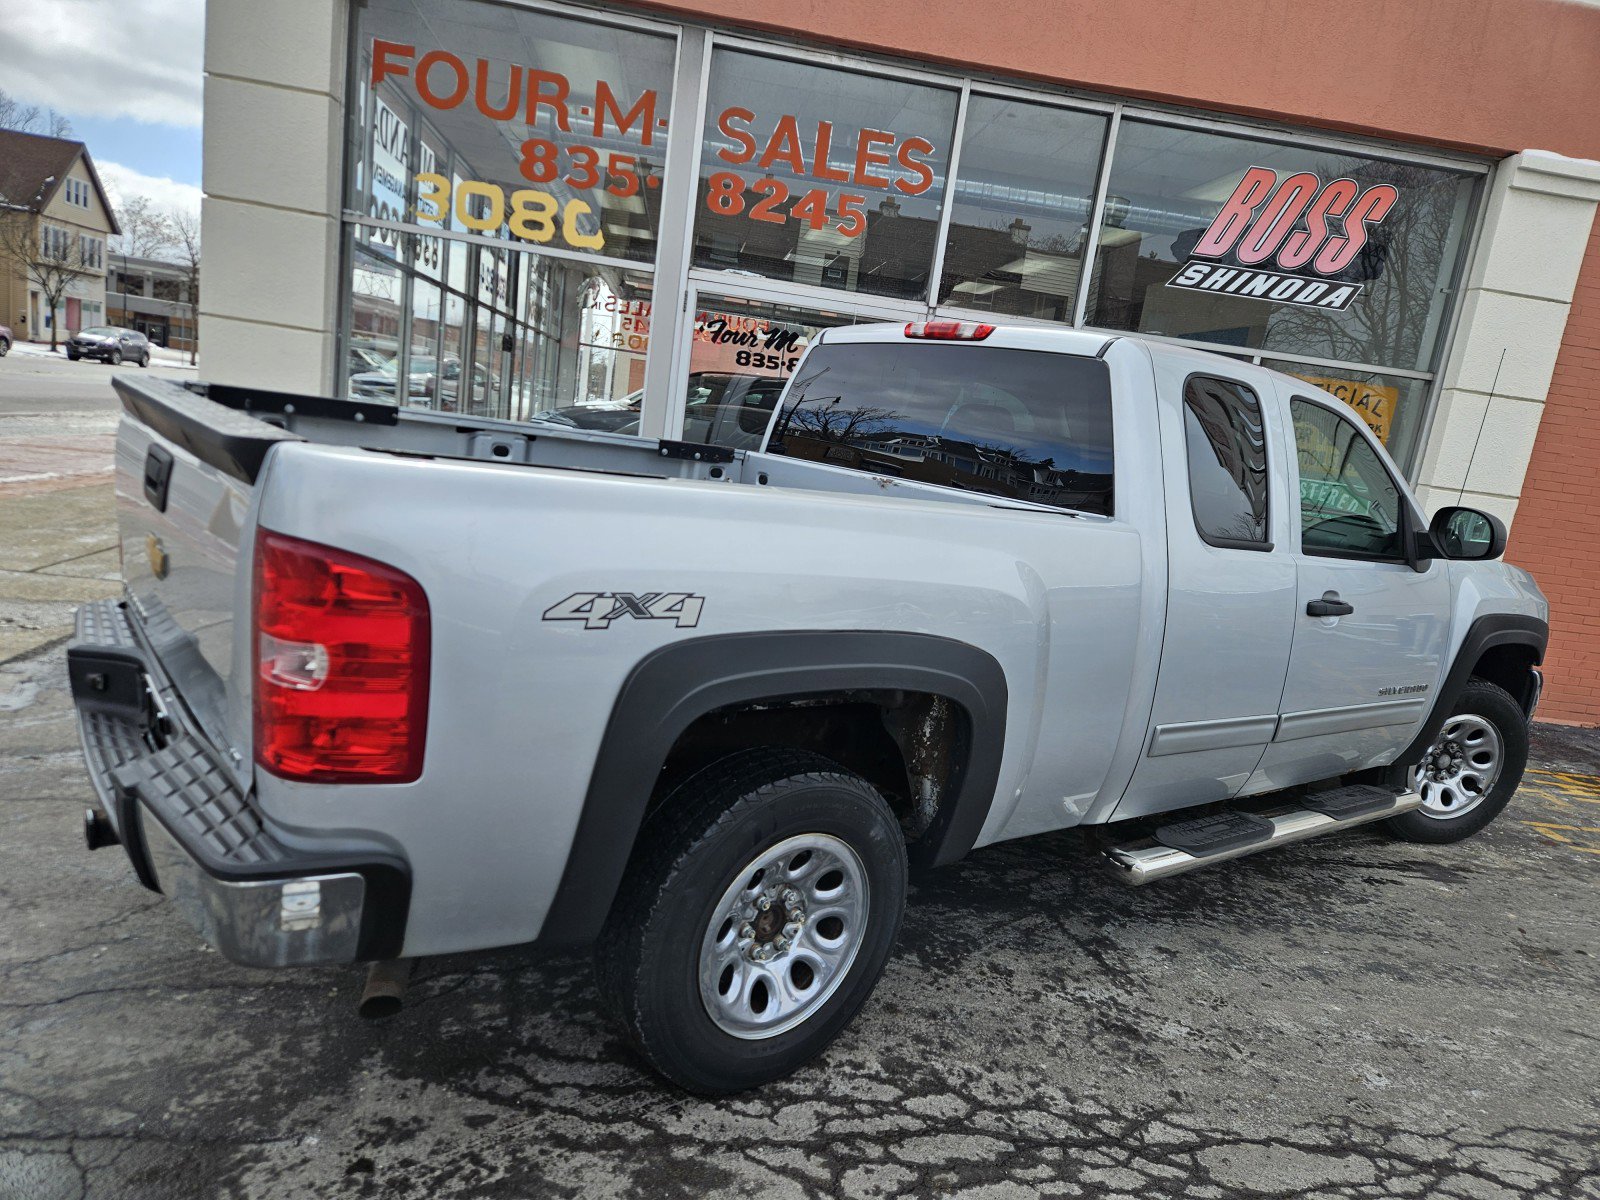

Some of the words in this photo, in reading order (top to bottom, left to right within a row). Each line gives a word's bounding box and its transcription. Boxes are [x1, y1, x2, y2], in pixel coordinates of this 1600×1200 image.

[716, 106, 936, 196] SALES
[706, 171, 868, 238] 8245
[1190, 165, 1399, 276] BOSS
[1174, 263, 1355, 308] SHINODA
[699, 319, 759, 349] Four
[759, 326, 799, 354] M
[1301, 482, 1360, 513] STERED
